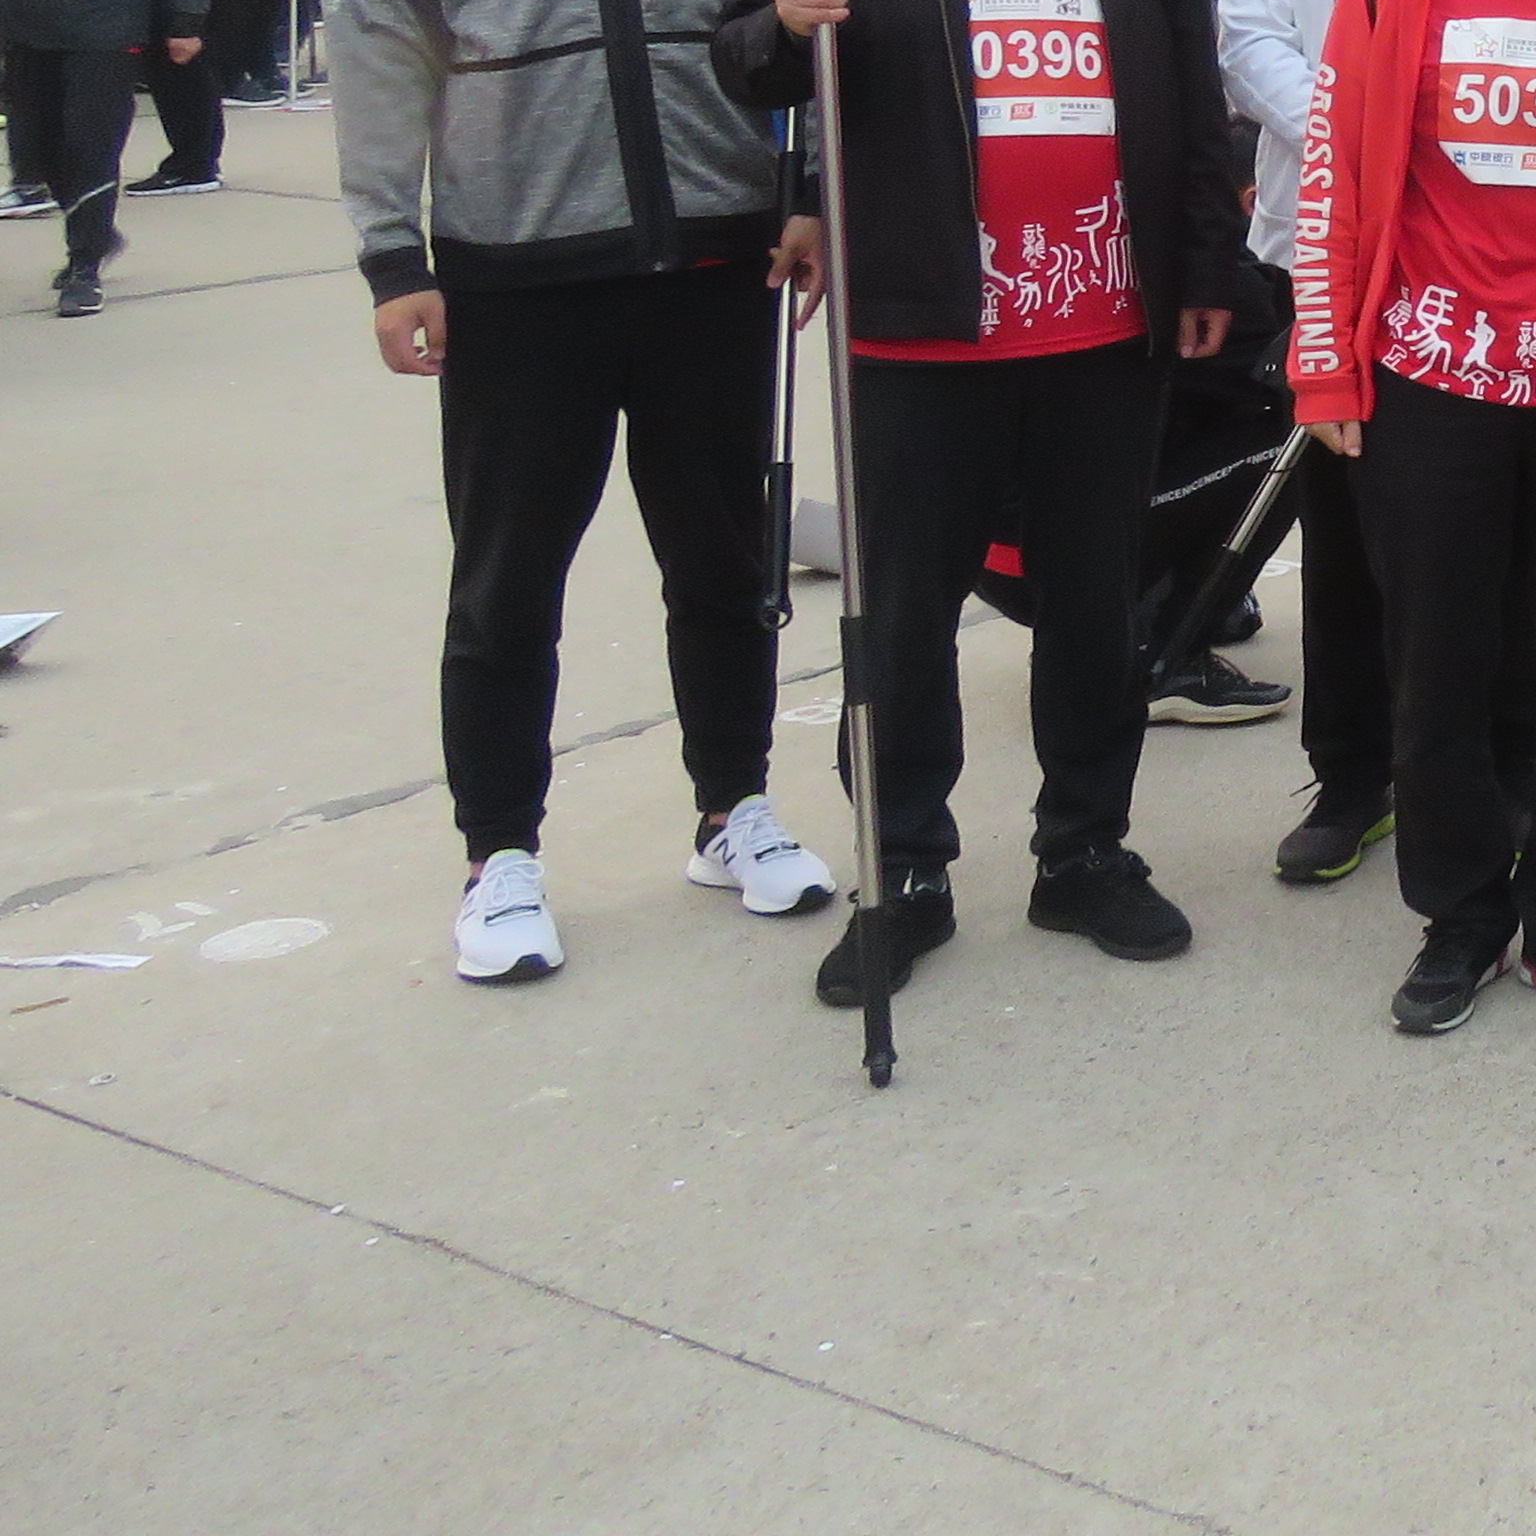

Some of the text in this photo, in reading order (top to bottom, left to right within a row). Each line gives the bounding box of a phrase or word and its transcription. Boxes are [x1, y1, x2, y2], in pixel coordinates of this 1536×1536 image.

[972, 29, 1103, 80] 0396
[1290, 63, 1341, 374] CROSS TRAINING
